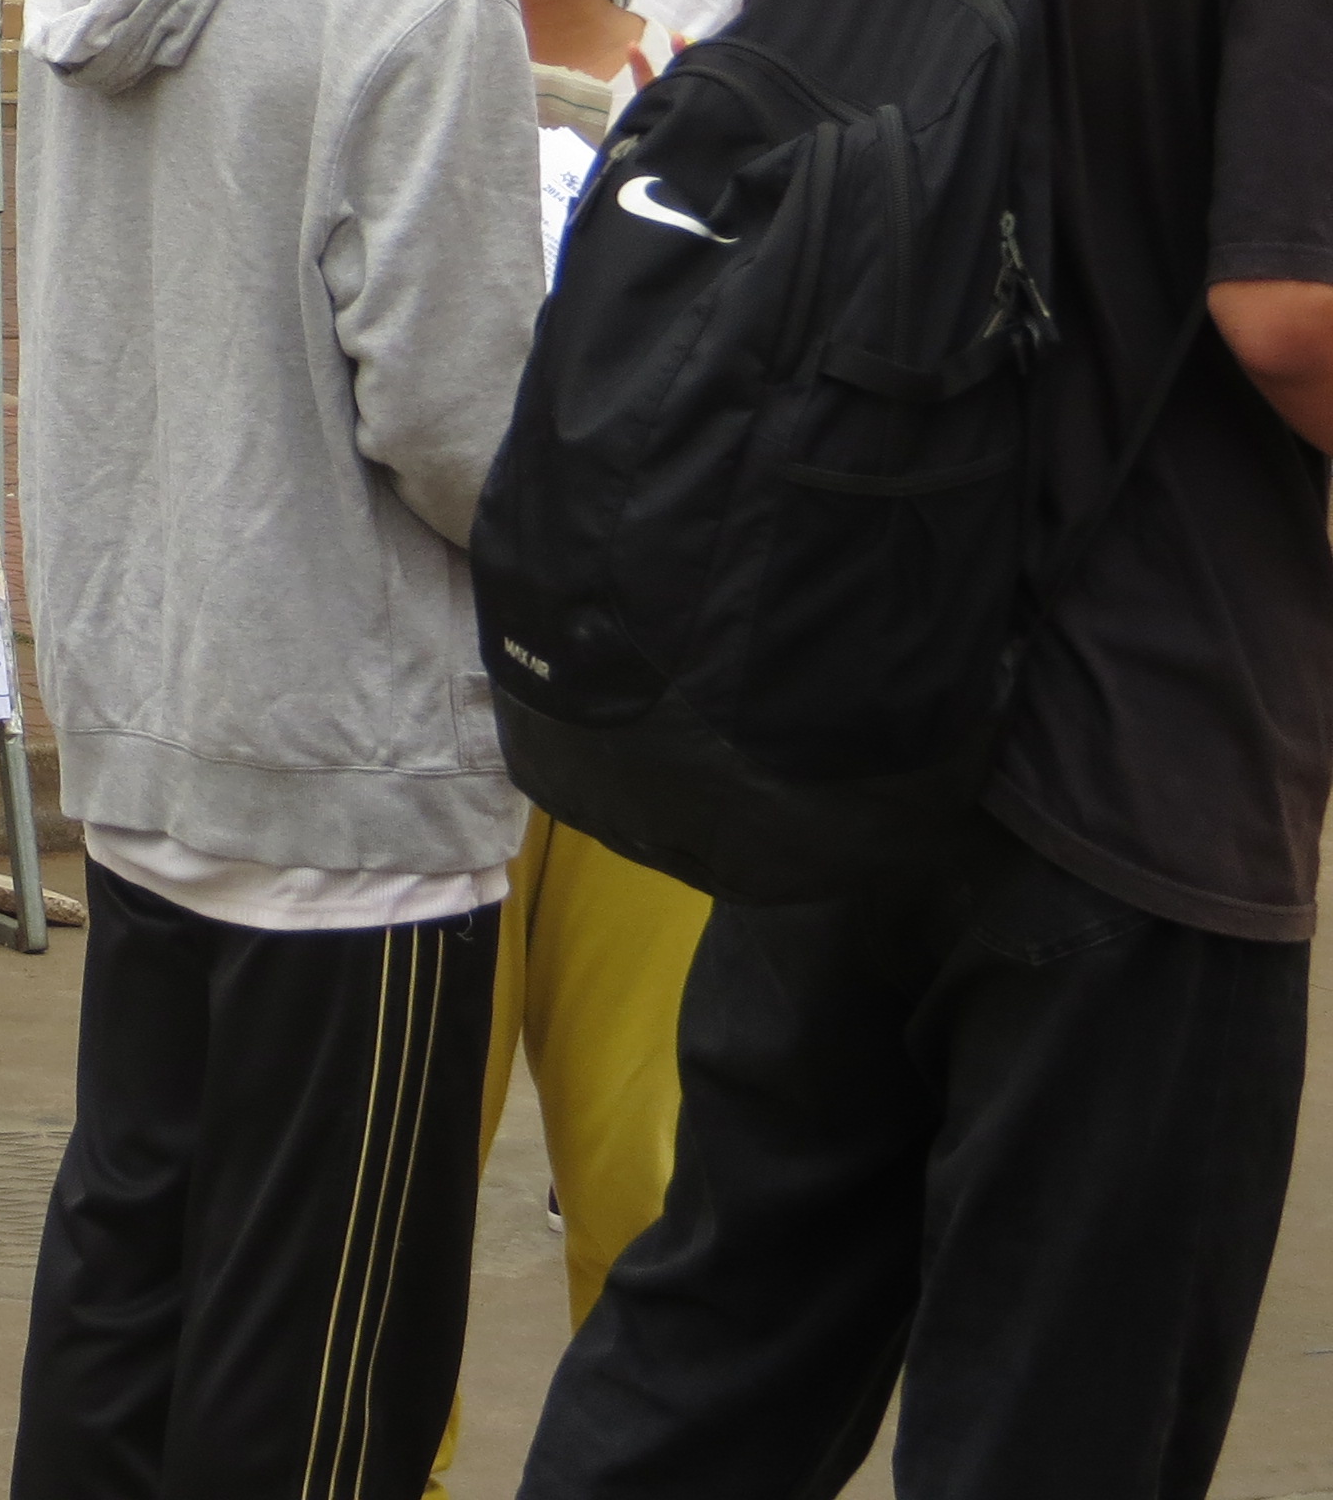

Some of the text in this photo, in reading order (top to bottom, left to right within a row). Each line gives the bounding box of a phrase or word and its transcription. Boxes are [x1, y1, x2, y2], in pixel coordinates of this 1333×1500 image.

[542, 183, 566, 203] 2014
[504, 636, 551, 681] MAX AIR
